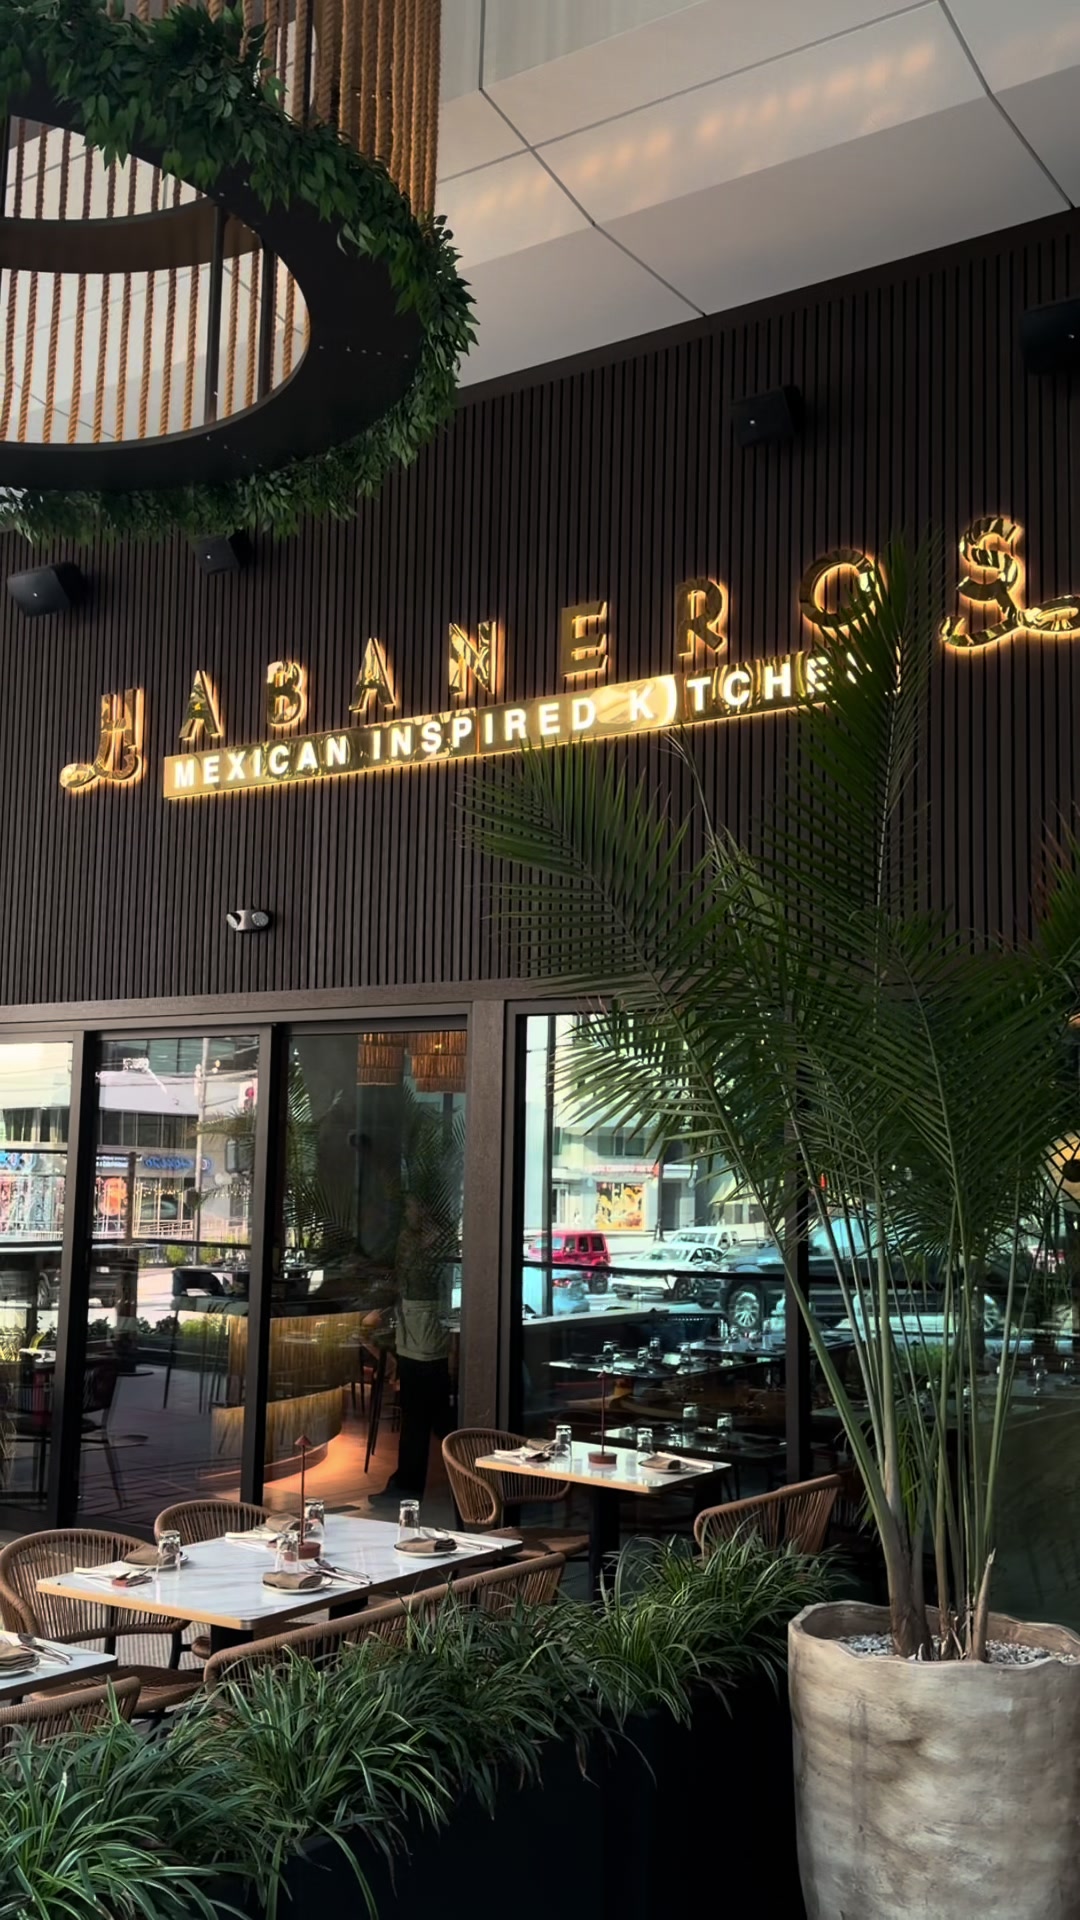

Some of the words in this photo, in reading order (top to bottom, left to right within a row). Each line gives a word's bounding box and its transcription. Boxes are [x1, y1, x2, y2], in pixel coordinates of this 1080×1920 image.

[60, 514, 1080, 792] HABANEROS
[174, 735, 347, 789] MEXICAN
[372, 697, 596, 761] INSPIRED
